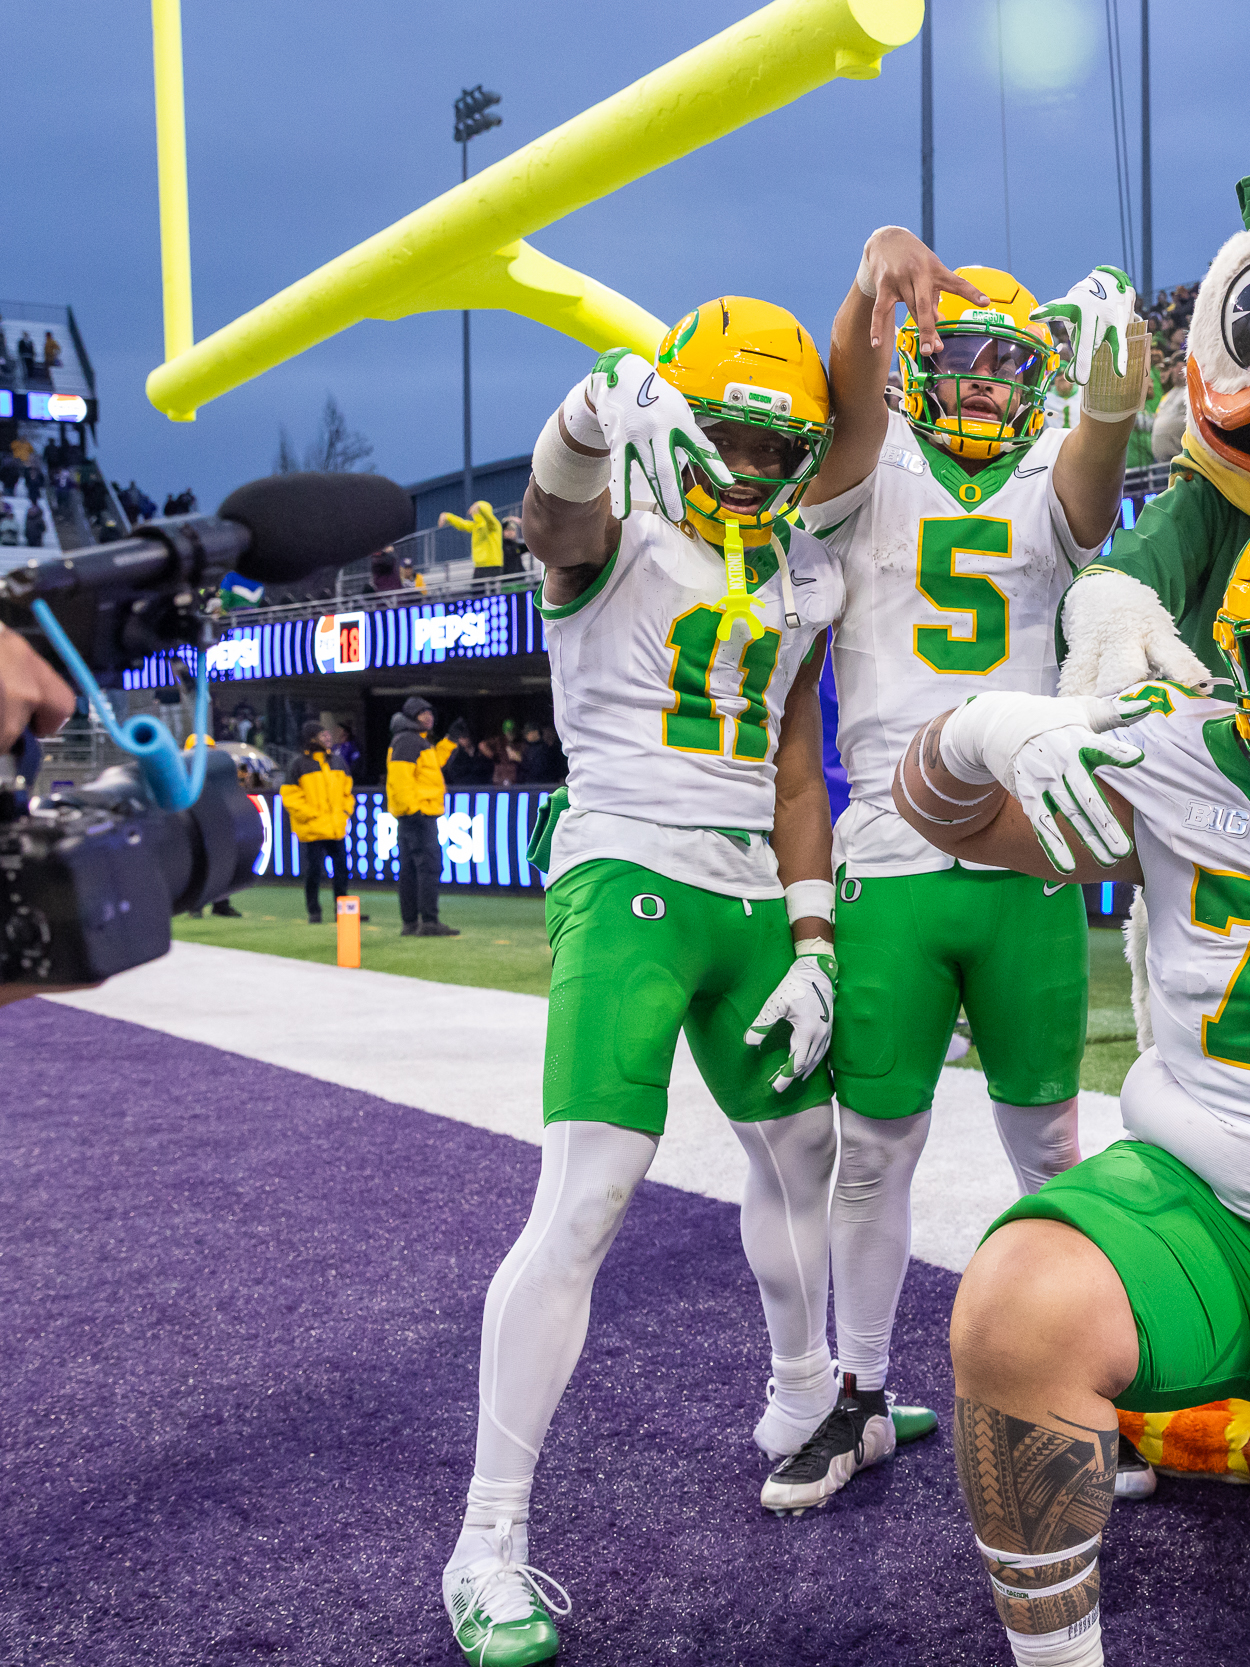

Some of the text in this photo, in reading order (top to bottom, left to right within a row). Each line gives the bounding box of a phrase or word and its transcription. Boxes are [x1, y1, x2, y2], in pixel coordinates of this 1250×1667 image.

[727, 552, 745, 590] NXTRND
[913, 515, 1012, 675] 5
[340, 627, 359, 663] 18
[414, 612, 486, 651] PEPSI
[663, 603, 782, 762] 11
